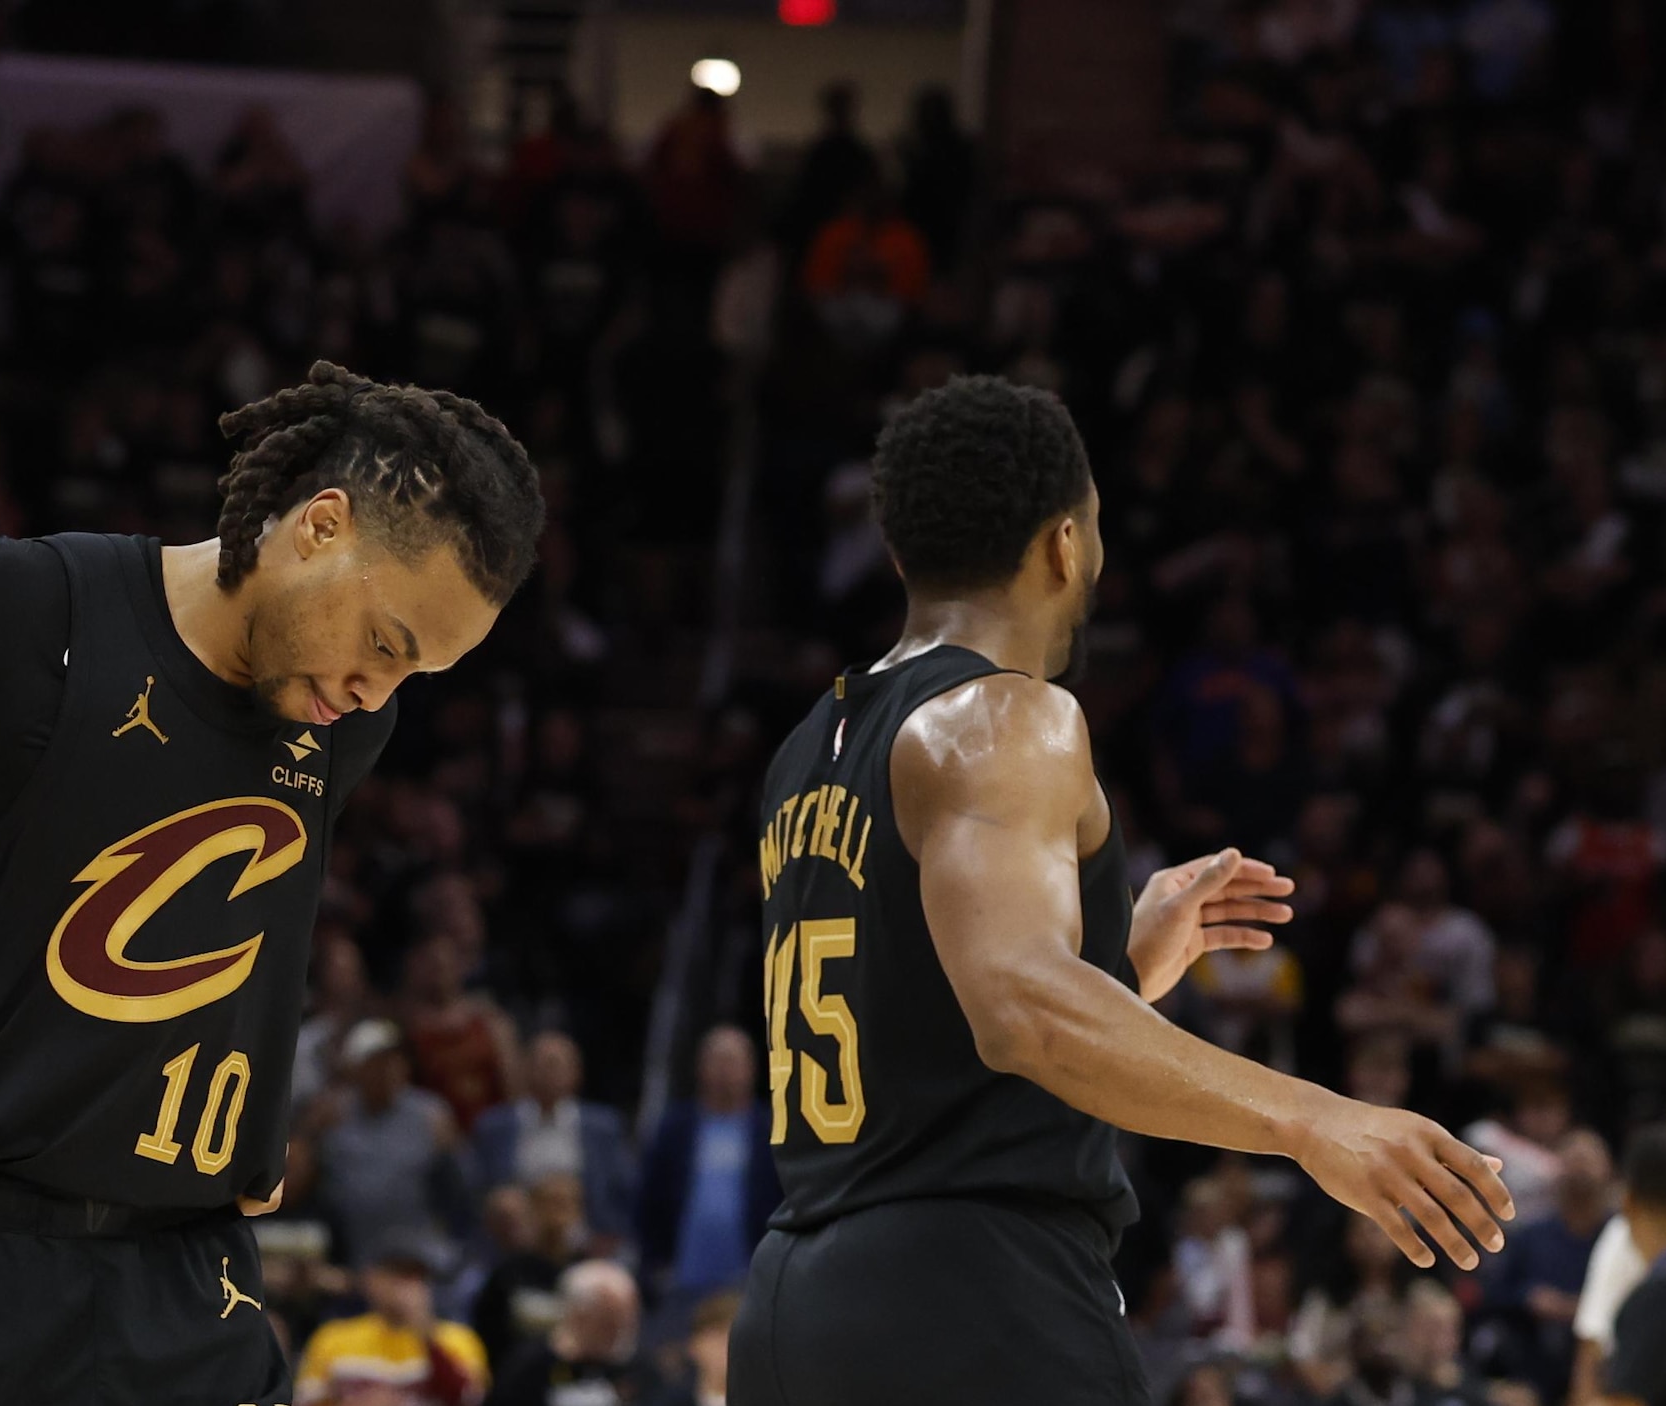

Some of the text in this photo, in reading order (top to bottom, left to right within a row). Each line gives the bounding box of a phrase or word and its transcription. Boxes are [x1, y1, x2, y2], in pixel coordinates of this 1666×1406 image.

[271, 765, 324, 797] CLIFFS
[760, 784, 872, 901] MITCHELL
[46, 796, 307, 1023] C
[134, 1042, 251, 1175] 10
